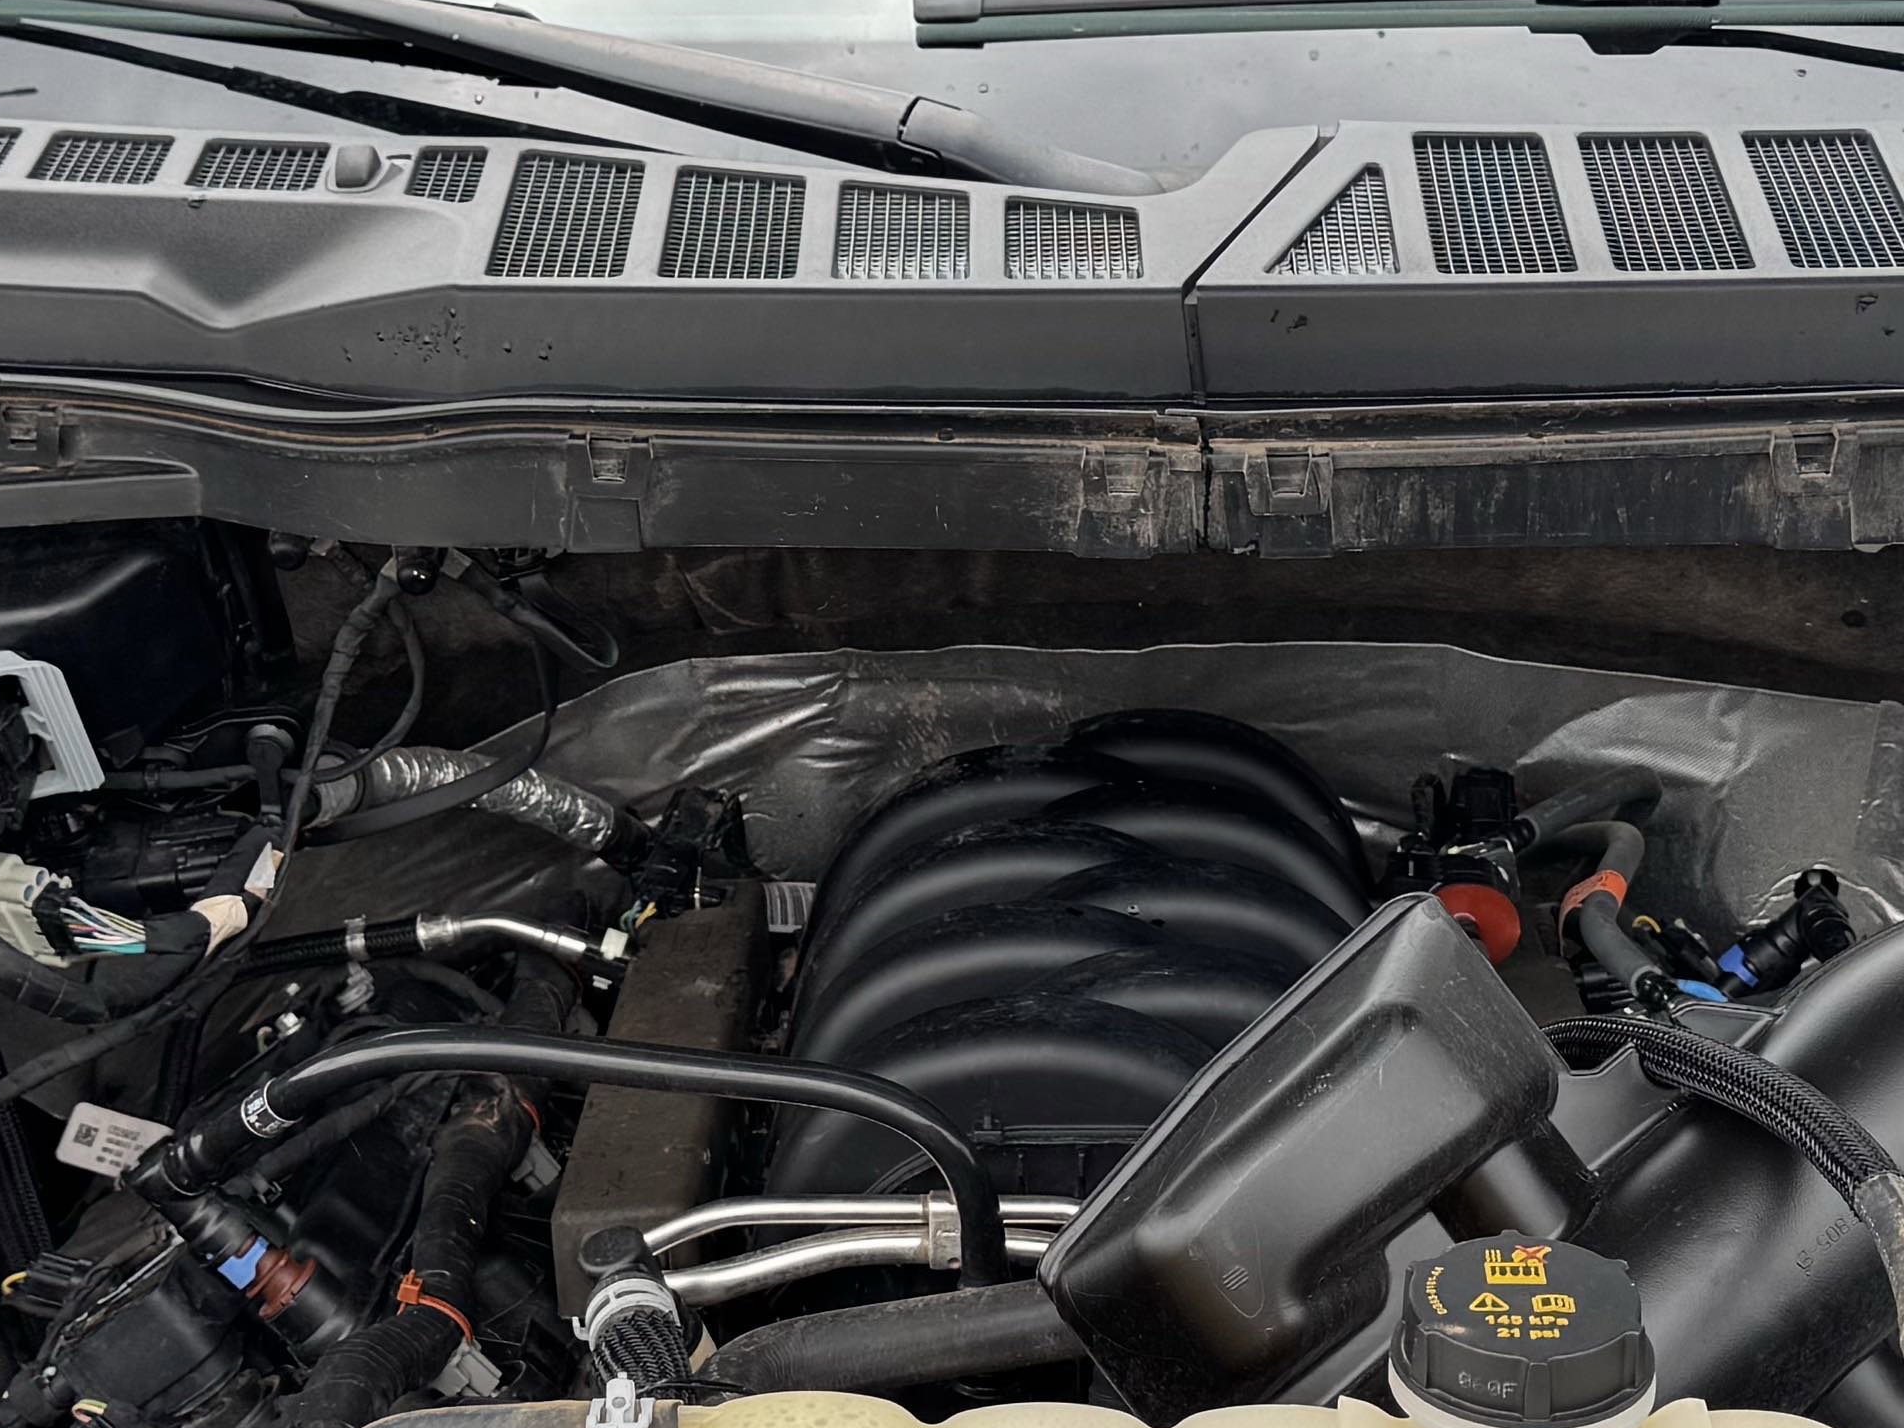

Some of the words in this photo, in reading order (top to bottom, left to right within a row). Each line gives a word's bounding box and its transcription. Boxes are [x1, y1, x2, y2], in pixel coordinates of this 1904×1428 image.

[1485, 1315, 1523, 1325] 145
[1496, 1328, 1521, 1338] 21
[1529, 1328, 1560, 1340] psi
